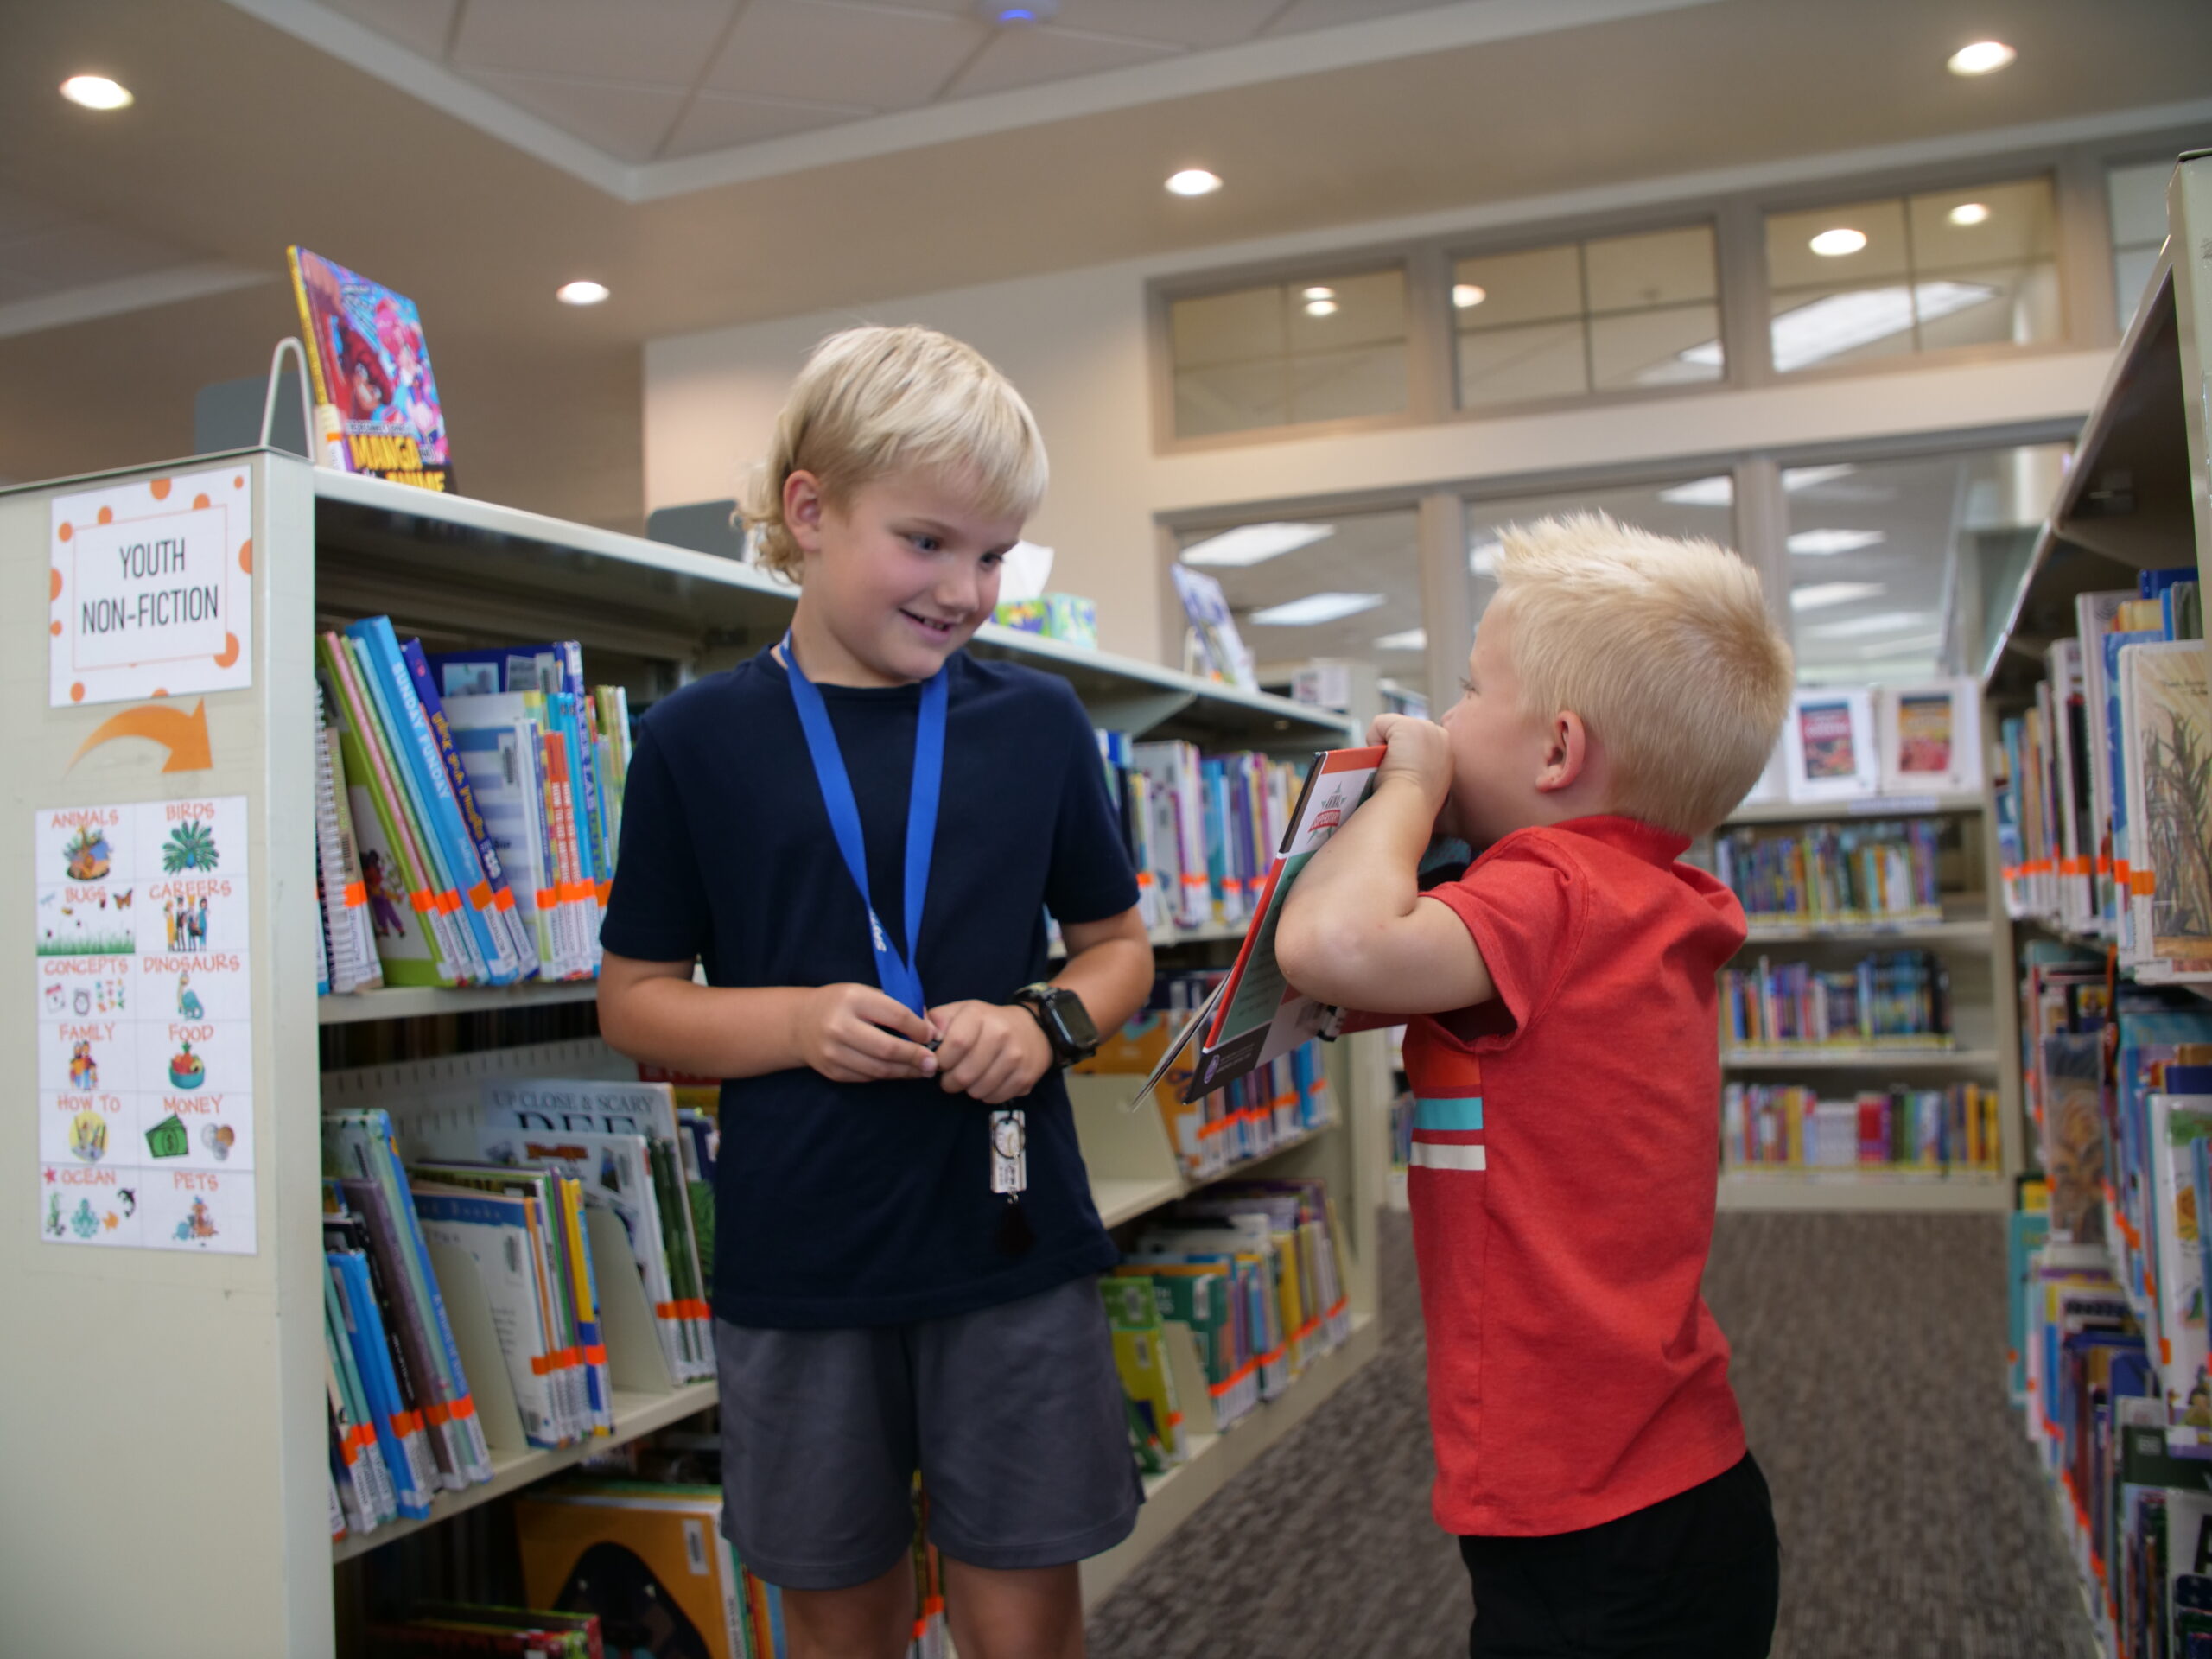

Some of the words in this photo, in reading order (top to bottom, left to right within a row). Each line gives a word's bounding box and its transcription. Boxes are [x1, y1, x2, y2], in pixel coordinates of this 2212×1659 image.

[347, 434, 423, 471] MANGA
[119, 537, 186, 580] YOUTH
[82, 584, 219, 635] NON-FICTION
[392, 661, 424, 729] SUNDAY
[417, 732, 451, 799] FUNDAY
[51, 809, 119, 829] ANIMALS
[165, 802, 215, 822] BIRDS
[65, 886, 106, 904] BUGS
[149, 880, 232, 900] CAREERS
[44, 957, 129, 976] CONCEPTS
[143, 954, 240, 975] DINOSAURS
[59, 1023, 116, 1042] FAMILY
[168, 1023, 214, 1042] FOOD
[57, 1094, 94, 1112] HOW
[99, 1094, 121, 1113] TO
[163, 1094, 224, 1115] MONEY
[521, 1091, 579, 1109] CLOSE
[581, 1095, 593, 1110] &
[597, 1095, 654, 1113] SCARY
[60, 1169, 117, 1185] OCEAN
[174, 1171, 219, 1192] PETS
